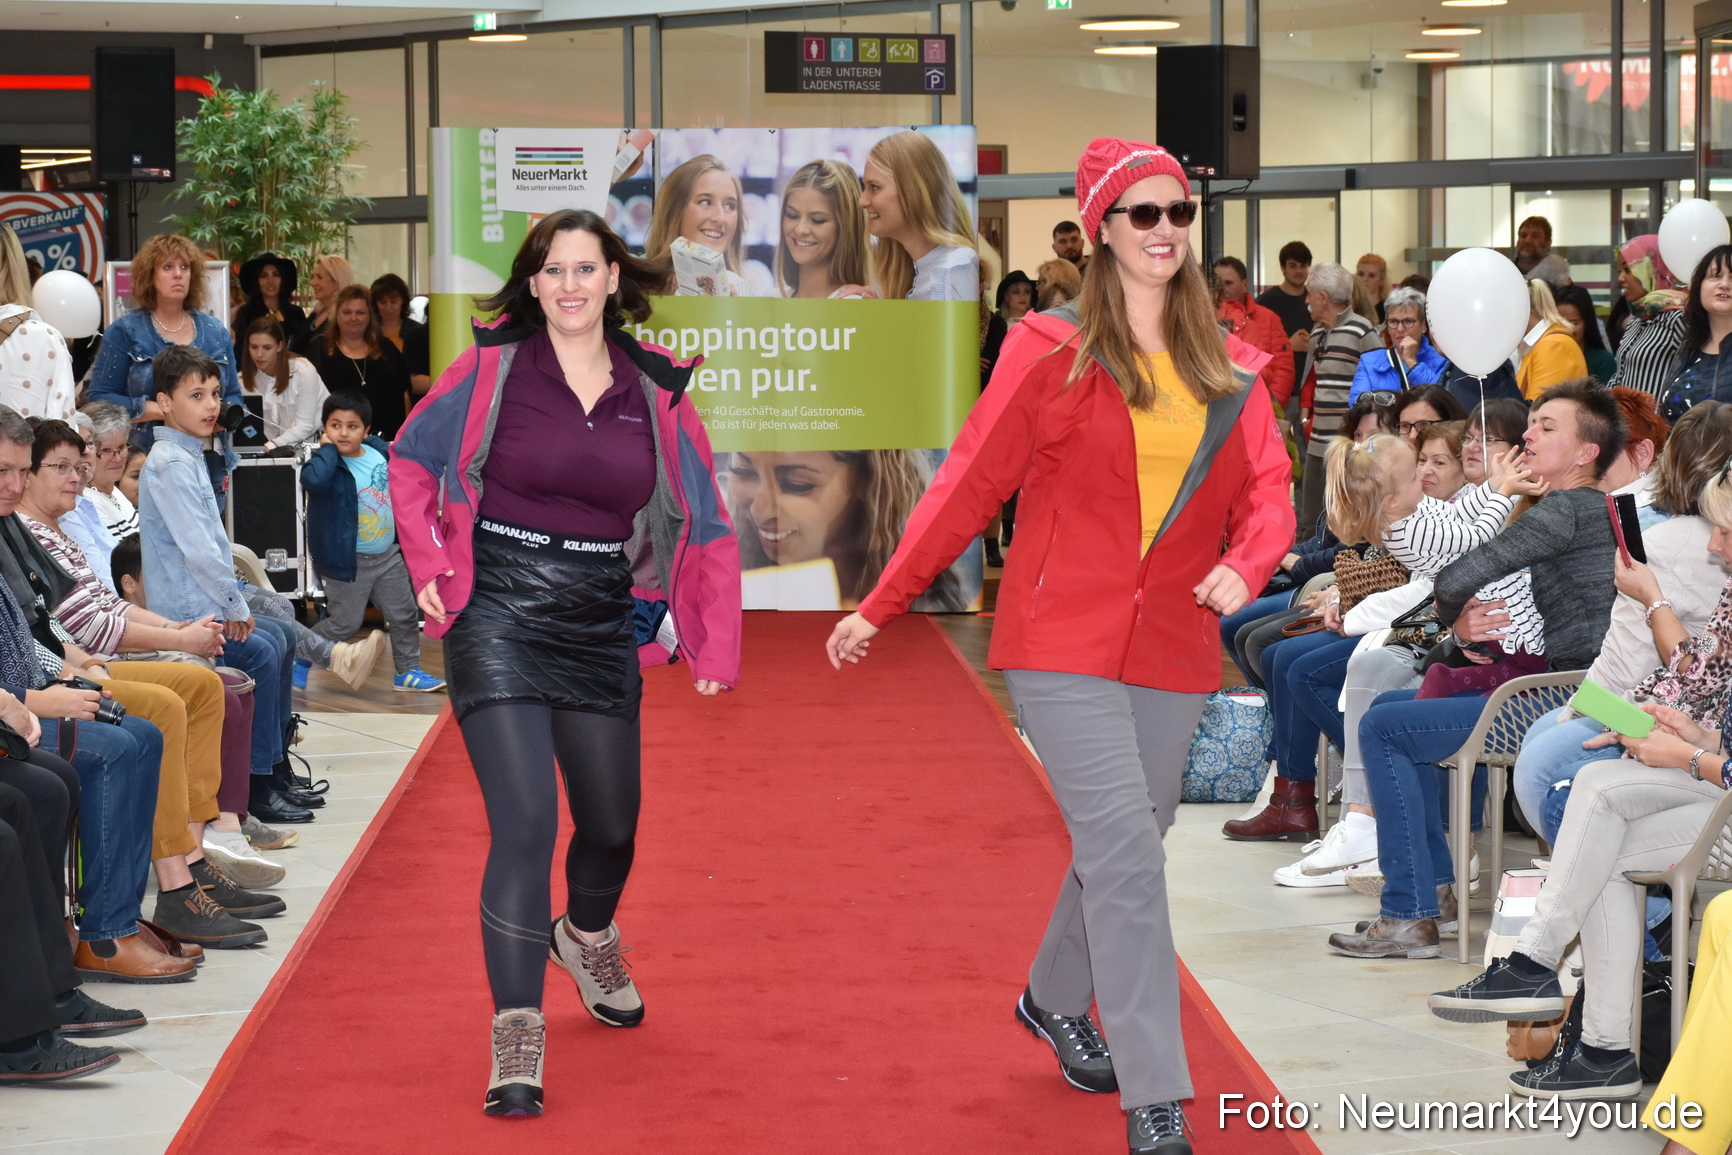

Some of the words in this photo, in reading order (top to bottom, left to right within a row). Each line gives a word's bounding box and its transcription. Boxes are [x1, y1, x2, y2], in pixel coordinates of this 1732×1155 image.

[803, 67, 812, 77] IN
[815, 67, 832, 77] DER
[836, 67, 881, 77] UNTEREN
[803, 80, 881, 90] LADENSTRASSE
[931, 75, 940, 88] P
[512, 168, 588, 180] NeuerMarkt
[625, 320, 857, 358] hoppingtour
[752, 367, 817, 398] pur.
[713, 406, 727, 416] 40
[729, 405, 779, 416] Geschäfte
[781, 406, 798, 416] auf
[800, 406, 865, 417] Gastronomie,
[712, 419, 726, 429] Da
[727, 419, 740, 429] ist
[742, 419, 757, 429] für
[759, 419, 787, 431] jeden
[811, 420, 840, 430] dabei.
[480, 520, 551, 544] KILIMANJARO
[563, 540, 623, 553] KILIMANJARO
